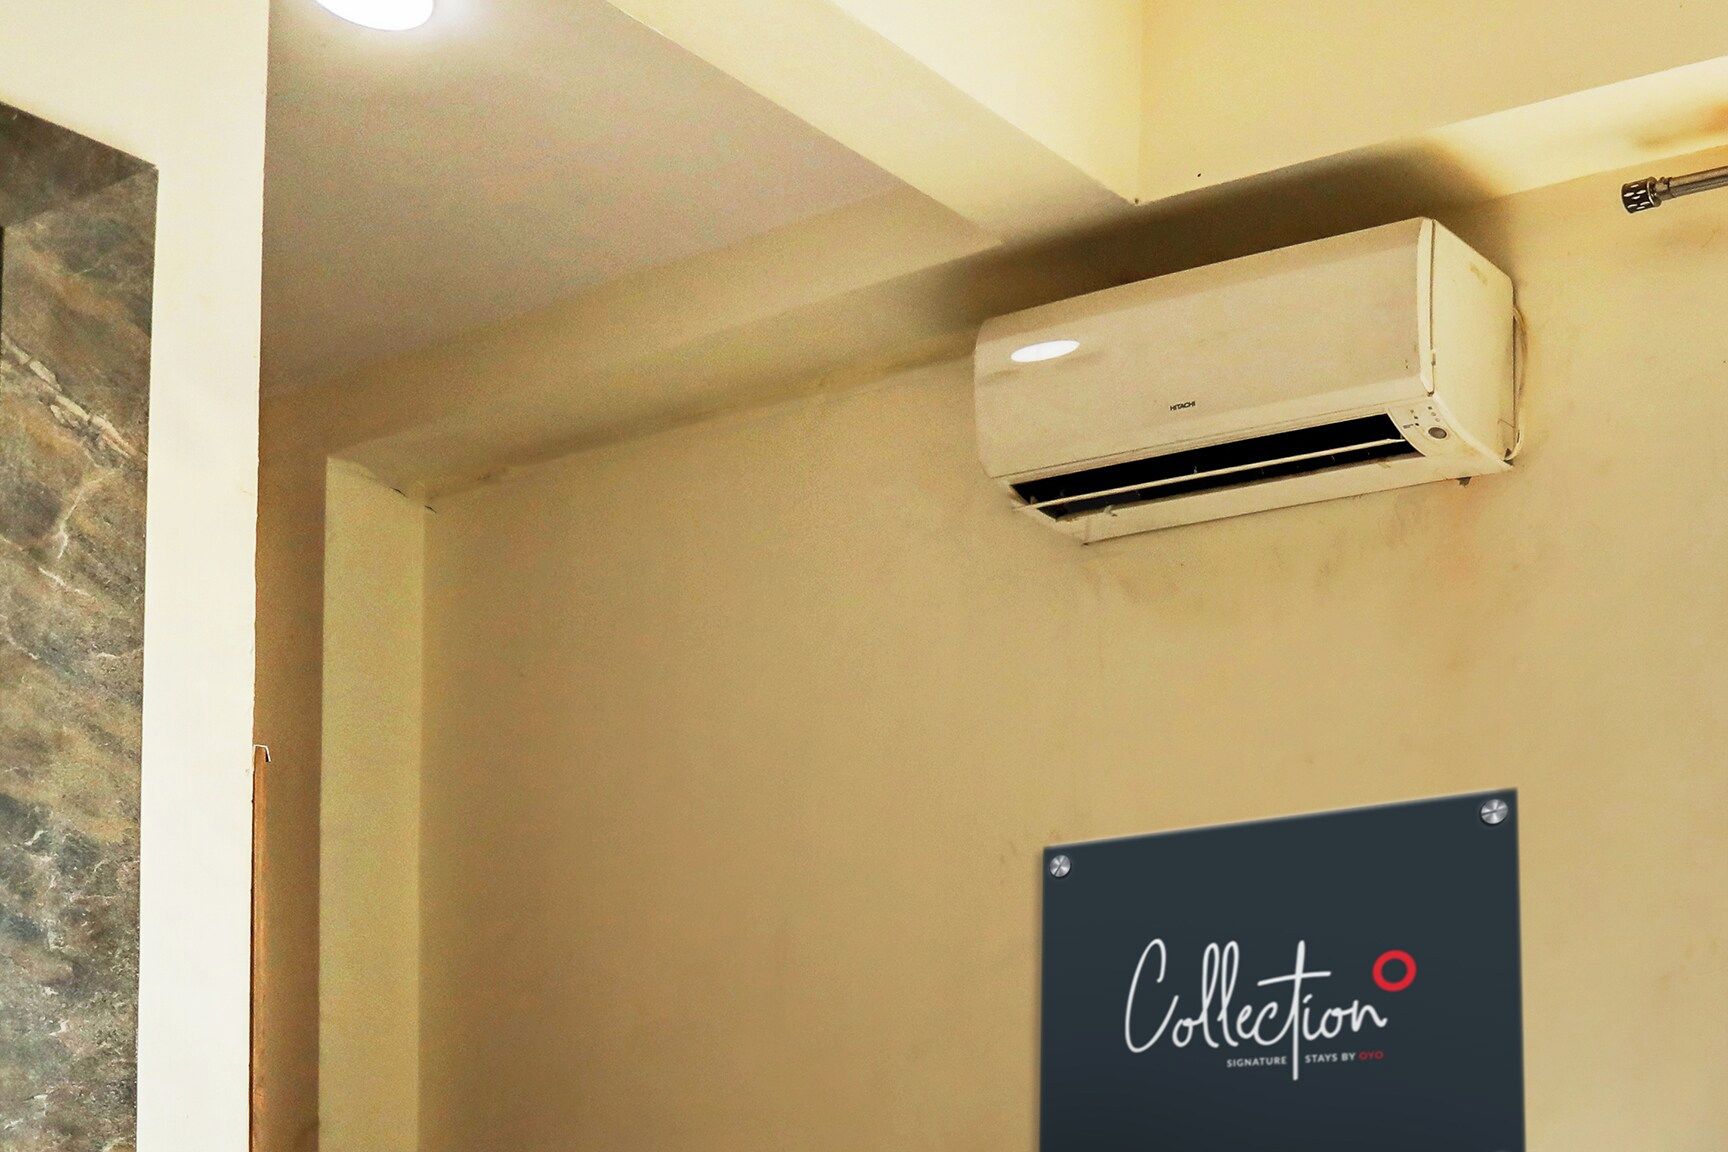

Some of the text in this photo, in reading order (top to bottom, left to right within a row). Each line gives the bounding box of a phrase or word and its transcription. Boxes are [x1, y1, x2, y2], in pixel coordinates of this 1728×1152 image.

[1125, 938, 1388, 1081] Collection
[1226, 1050, 1384, 1068] SIGNATURE STAYS BY OYO
